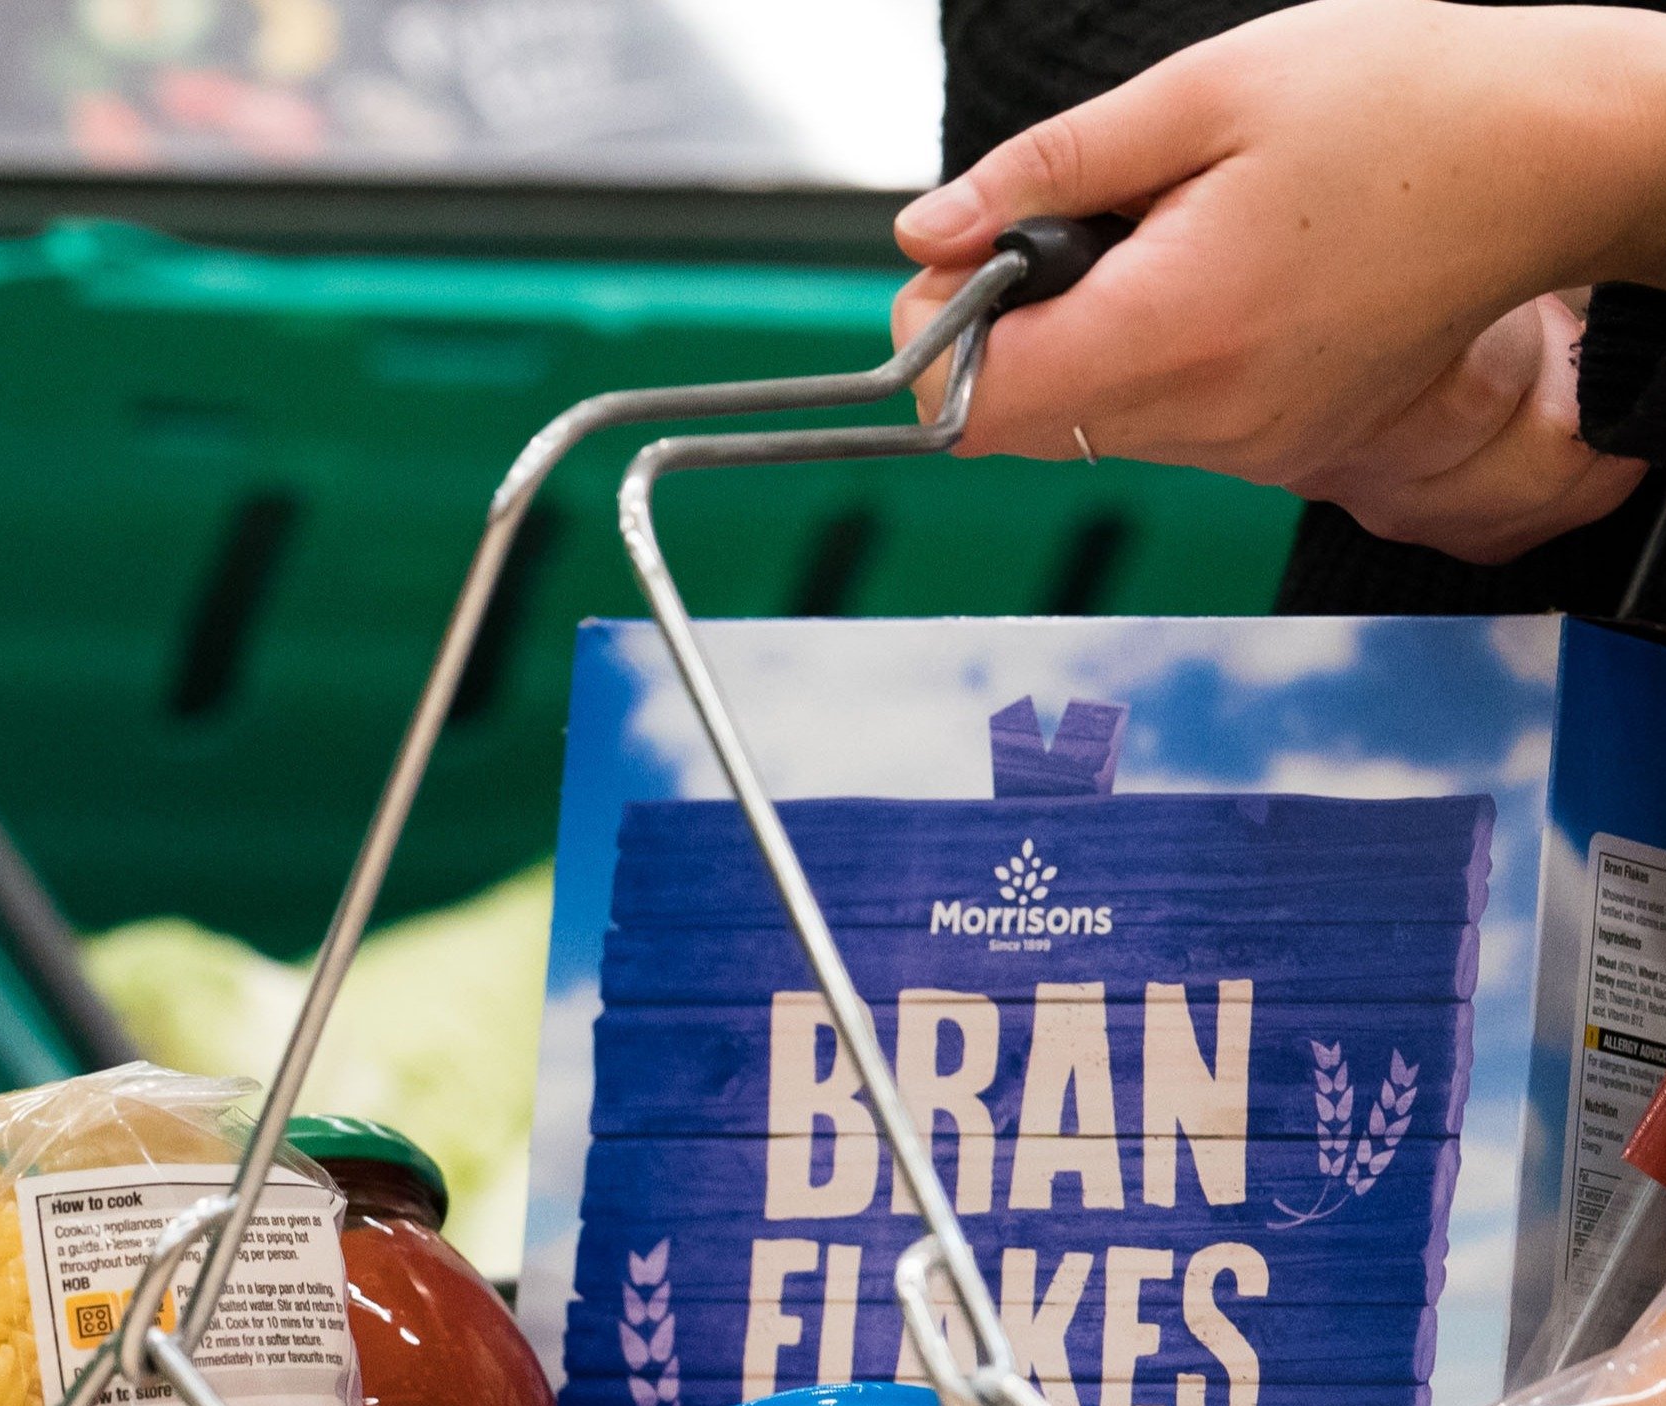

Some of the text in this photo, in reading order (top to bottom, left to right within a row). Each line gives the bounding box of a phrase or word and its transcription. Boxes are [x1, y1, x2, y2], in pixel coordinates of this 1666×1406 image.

[1604, 859, 1649, 884] Bran Flakes
[930, 900, 1113, 936] Morrisons
[989, 939, 1021, 951] Since
[1598, 926, 1642, 950] Ingredients
[1602, 1032, 1637, 1056] ALLERGY
[765, 979, 1253, 1221] BRAN
[1585, 1098, 1618, 1121] Nutrition
[52, 1191, 143, 1215] How to cook
[55, 1224, 101, 1239] Cooking
[104, 1218, 163, 1236] appliances
[271, 1217, 286, 1227] are
[287, 1214, 315, 1229] given
[312, 1216, 322, 1226] as
[58, 1245, 65, 1257] a
[257, 1231, 265, 1242] is
[267, 1231, 294, 1245] piping
[295, 1231, 309, 1243] hot
[60, 1257, 122, 1274] throughout
[125, 1253, 151, 1266] befo
[250, 1250, 264, 1261] per
[268, 1249, 299, 1262] person.
[62, 1276, 91, 1292] HOB
[236, 1282, 245, 1294] in
[247, 1283, 253, 1294] a
[254, 1282, 277, 1297] large
[279, 1282, 296, 1297] pan
[297, 1282, 306, 1294] of
[218, 1300, 343, 1312] salted water. Stir and return to
[226, 1318, 250, 1330] Cook
[252, 1317, 264, 1329] for
[267, 1317, 278, 1329] 10
[280, 1317, 301, 1329] mins
[303, 1317, 314, 1329] for
[199, 1333, 324, 1349] 12 mins for a softer texture.
[193, 1350, 324, 1367] mmediately in your favourite
[136, 1384, 172, 1400] store
